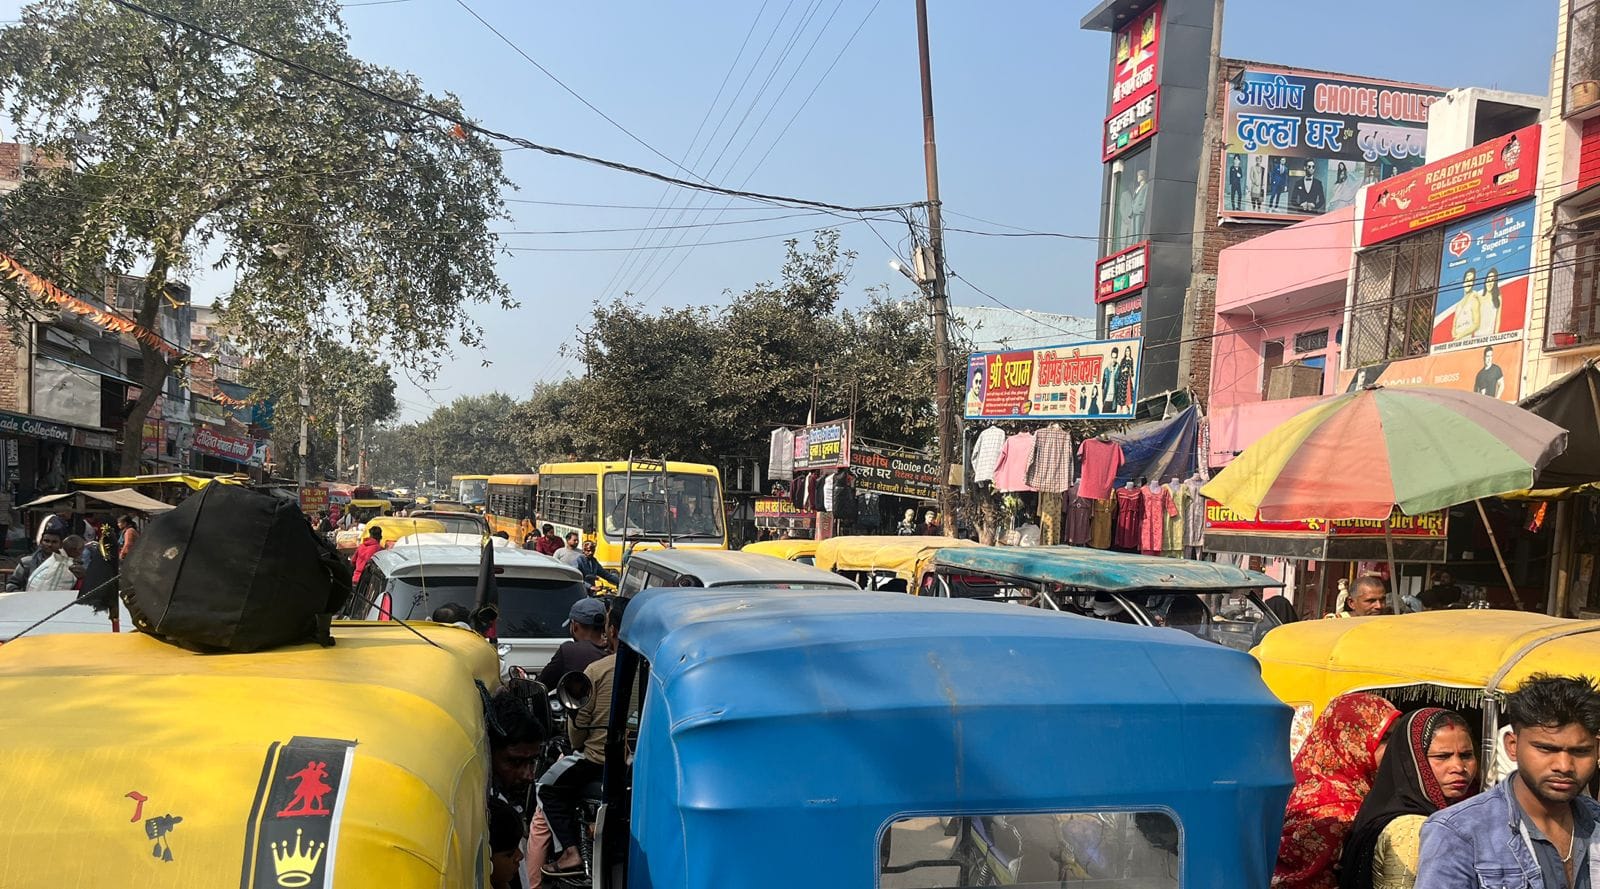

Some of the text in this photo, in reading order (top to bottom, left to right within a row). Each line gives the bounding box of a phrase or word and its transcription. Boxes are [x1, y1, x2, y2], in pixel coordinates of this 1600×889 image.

[1237, 76, 1304, 110] आशीष
[1314, 83, 1377, 117] CHOICE
[1237, 113, 1301, 151] दुल्हा
[1305, 118, 1345, 152] घर
[1425, 150, 1495, 184] READYMADE
[1431, 167, 1484, 192] COLLECTION
[1494, 221, 1526, 239] hamesha
[989, 354, 1003, 390] श्री
[1004, 360, 1032, 390] श्याम
[21, 420, 69, 442] Collection
[852, 453, 888, 468] आशीष
[892, 459, 922, 473] Choice
[876, 468, 892, 479] घर
